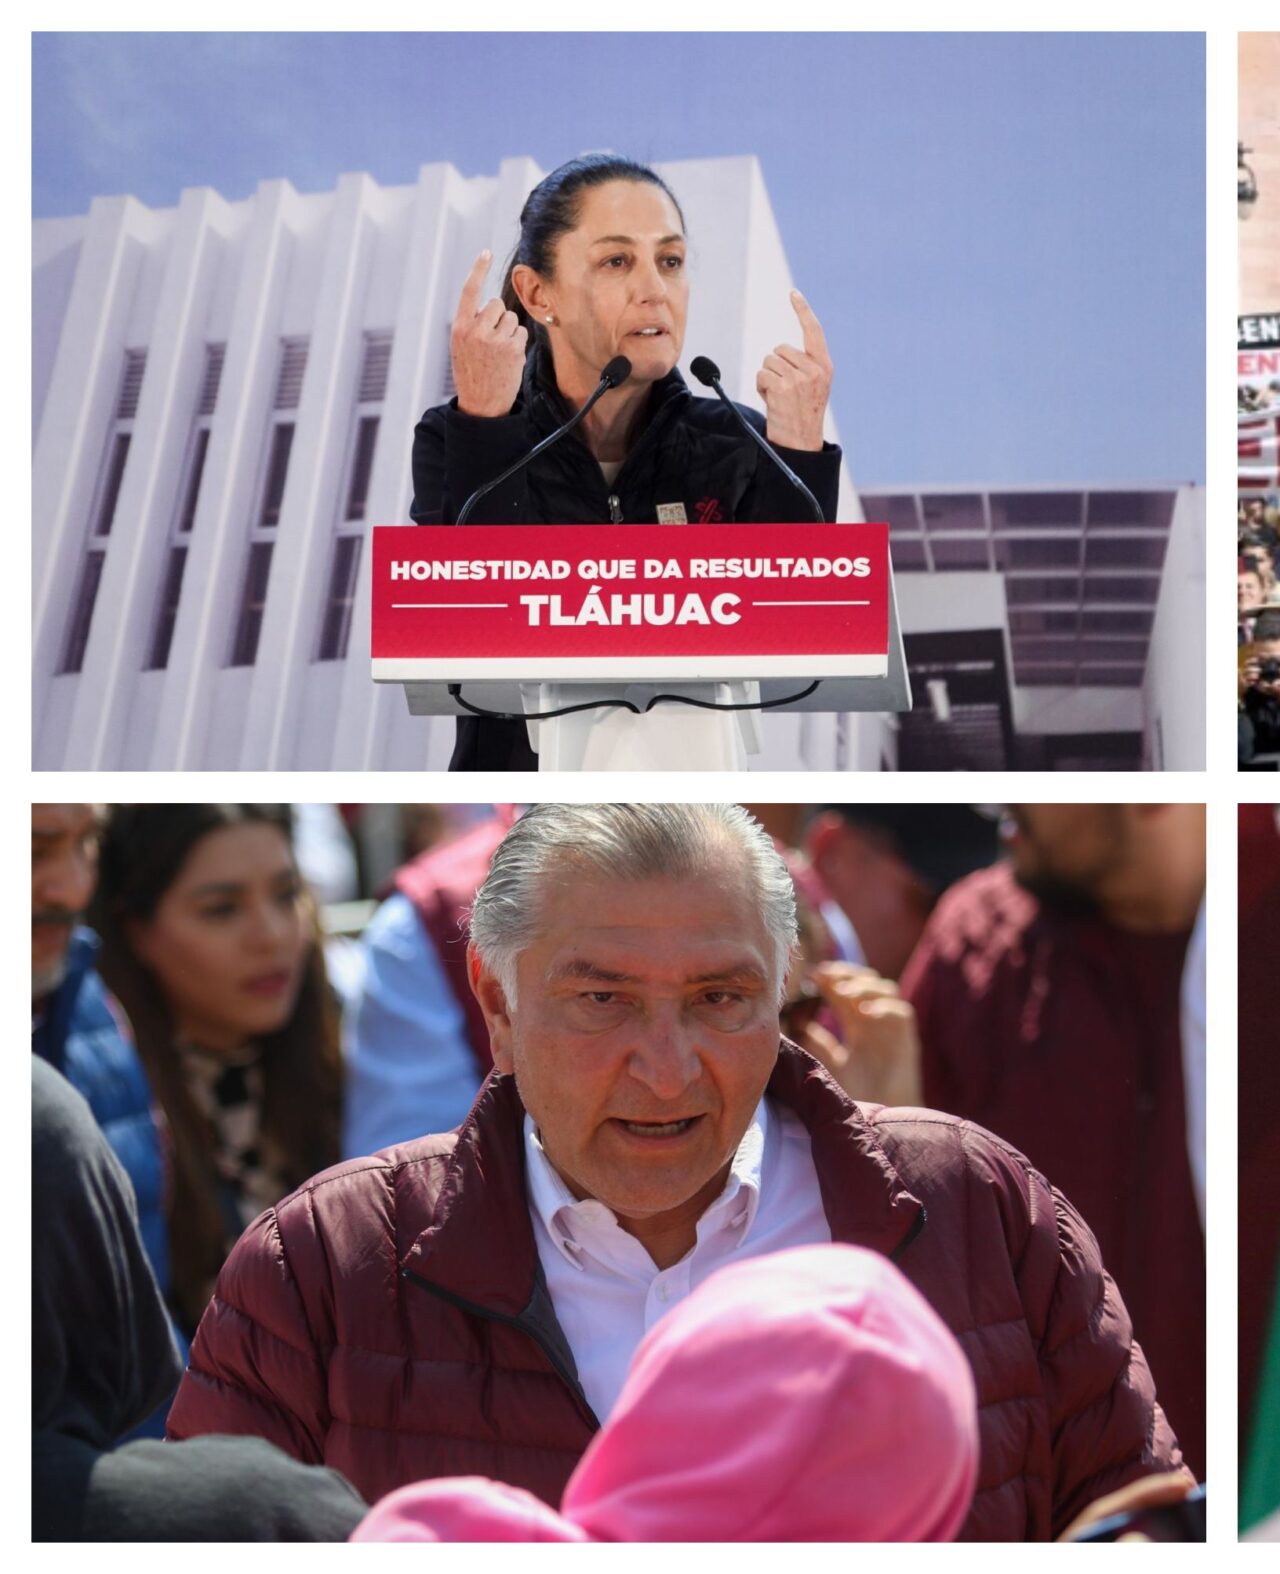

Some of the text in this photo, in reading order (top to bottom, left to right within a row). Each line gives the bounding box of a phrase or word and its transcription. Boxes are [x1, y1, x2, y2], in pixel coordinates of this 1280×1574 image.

[390, 557, 871, 581] HONESTIDAD QUE DA RESULTADOS
[519, 585, 742, 626] TLÁHUAC
